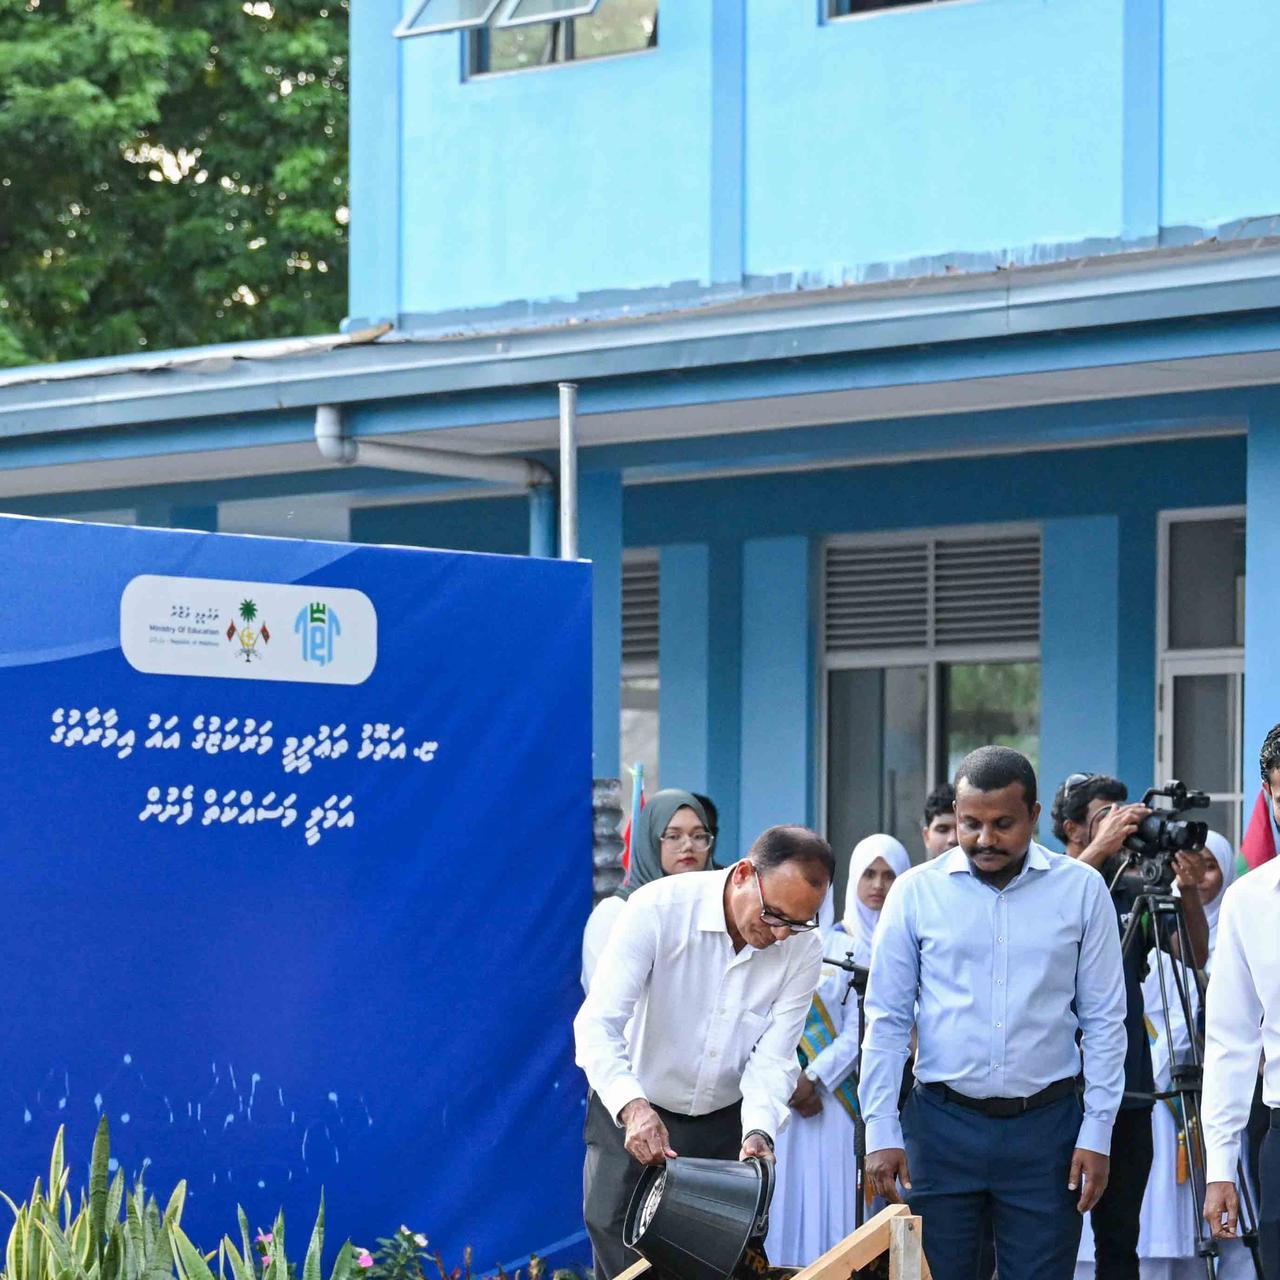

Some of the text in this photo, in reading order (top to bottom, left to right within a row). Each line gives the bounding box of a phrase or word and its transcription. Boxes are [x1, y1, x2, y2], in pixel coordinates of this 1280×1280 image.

[149, 624, 219, 635] Ministry Of Education
